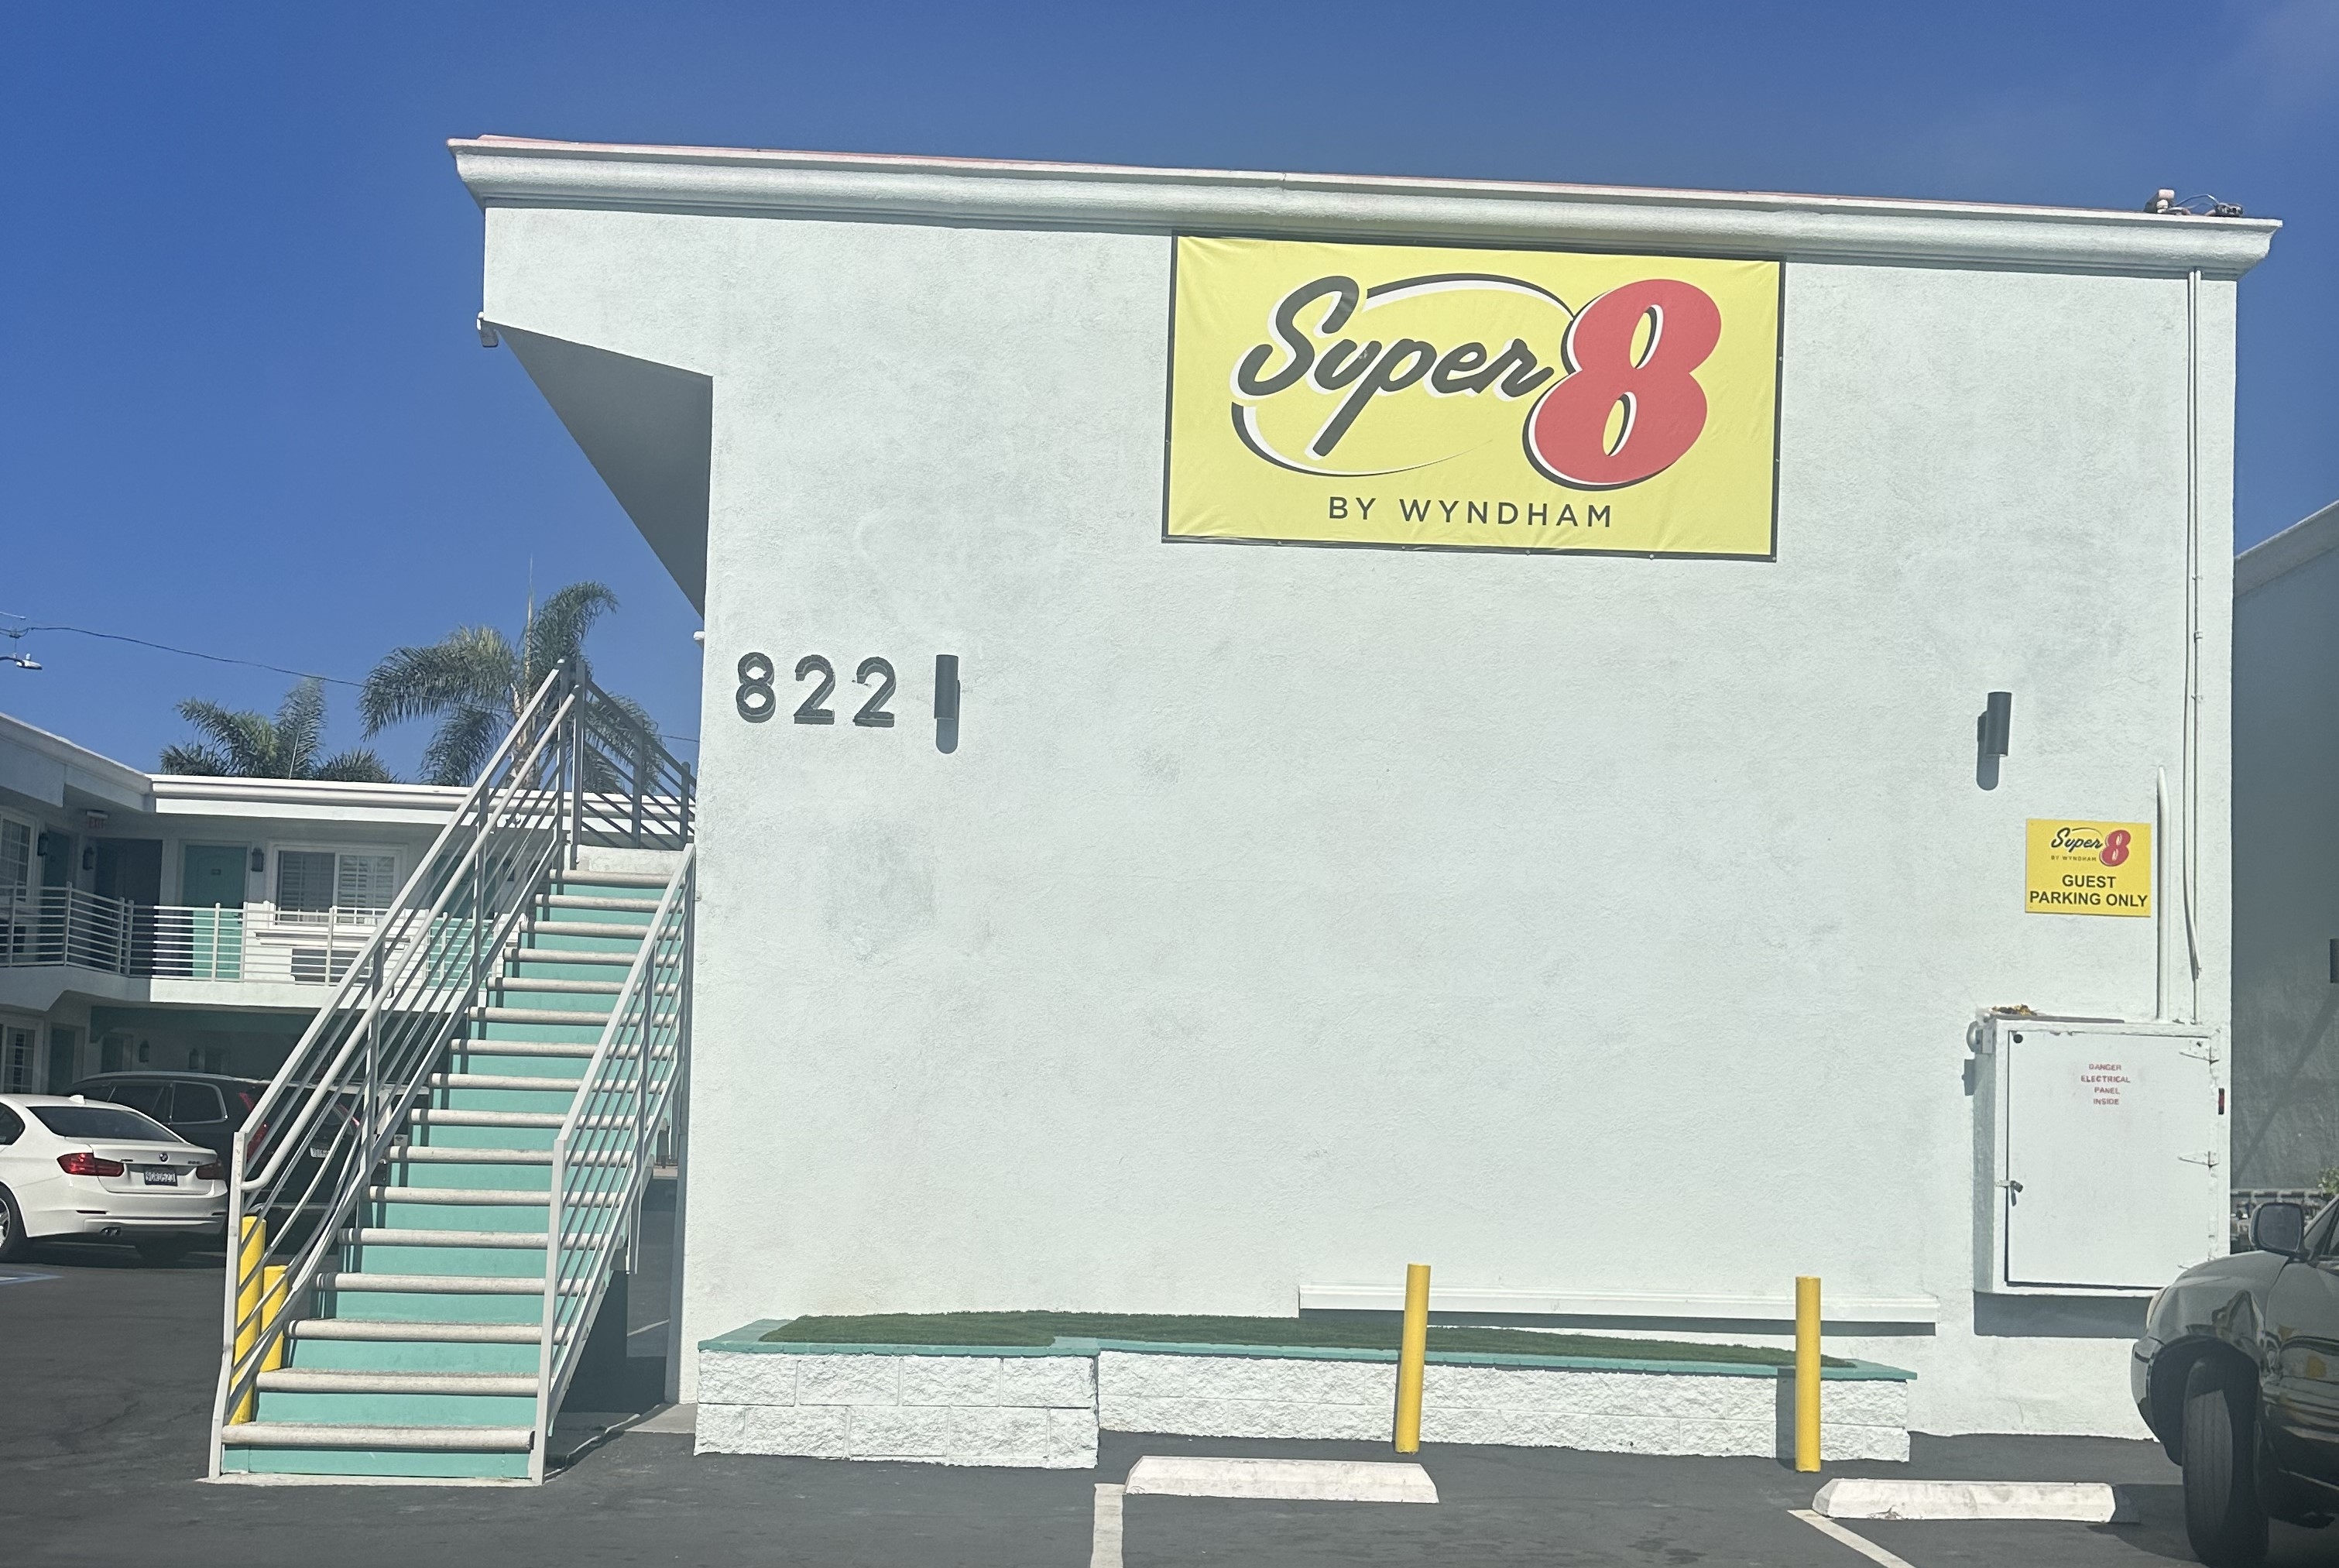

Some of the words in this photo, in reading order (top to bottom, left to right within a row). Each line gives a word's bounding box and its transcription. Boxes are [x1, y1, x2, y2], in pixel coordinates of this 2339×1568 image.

[1238, 276, 1555, 457] Super
[1522, 280, 1721, 491] 8
[1329, 496, 1377, 520] BY
[1399, 499, 1611, 528] WYNDHAM
[736, 651, 897, 728] 822
[2051, 827, 2103, 853] Super
[2099, 829, 2132, 867] 8
[2062, 874, 2116, 888] GUEST
[2030, 890, 2101, 905] PARKING
[2106, 894, 2149, 907] ONLY
[2080, 1075, 2131, 1083] ELECTRICAL
[2094, 1086, 2121, 1095] PANEL
